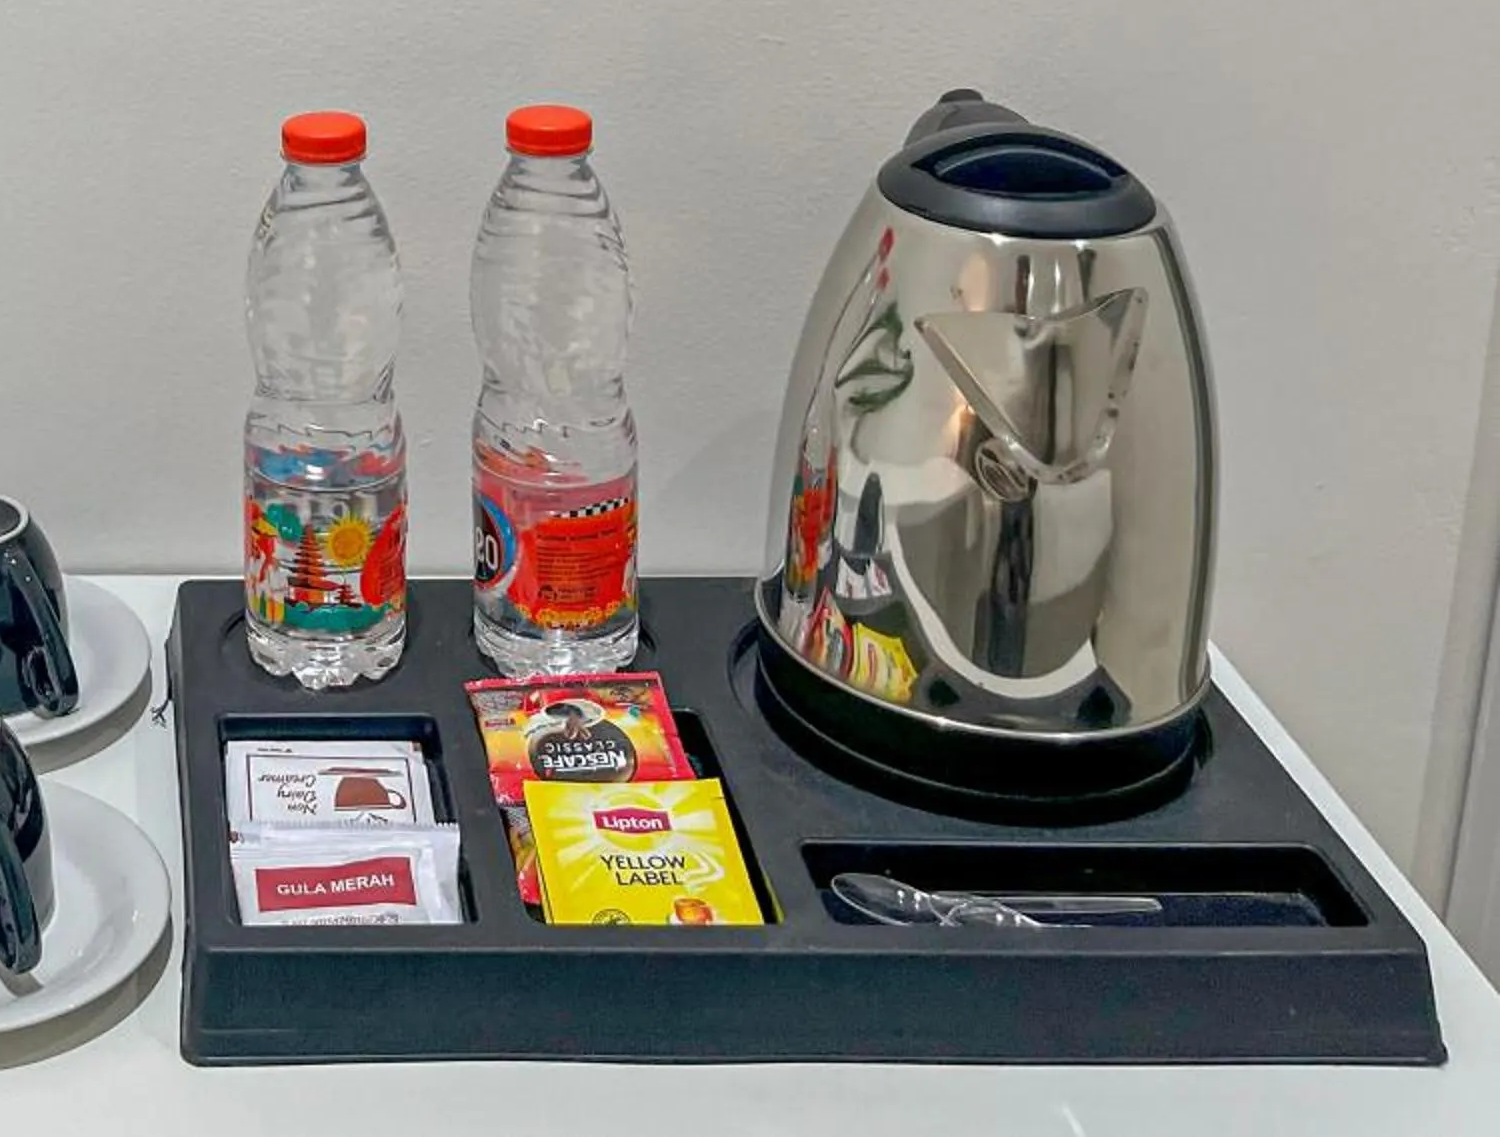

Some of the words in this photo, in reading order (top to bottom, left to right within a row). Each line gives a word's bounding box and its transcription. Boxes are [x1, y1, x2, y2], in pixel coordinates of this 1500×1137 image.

[544, 740, 616, 754] CLASSIC
[258, 774, 317, 788] Creamer
[277, 784, 317, 803] Dairy
[287, 803, 318, 816] Non
[601, 815, 663, 833] Lipton
[601, 855, 686, 871] YELLOW
[276, 880, 327, 896] GULA
[331, 873, 395, 893] MERAH
[616, 871, 684, 886] LABEL
